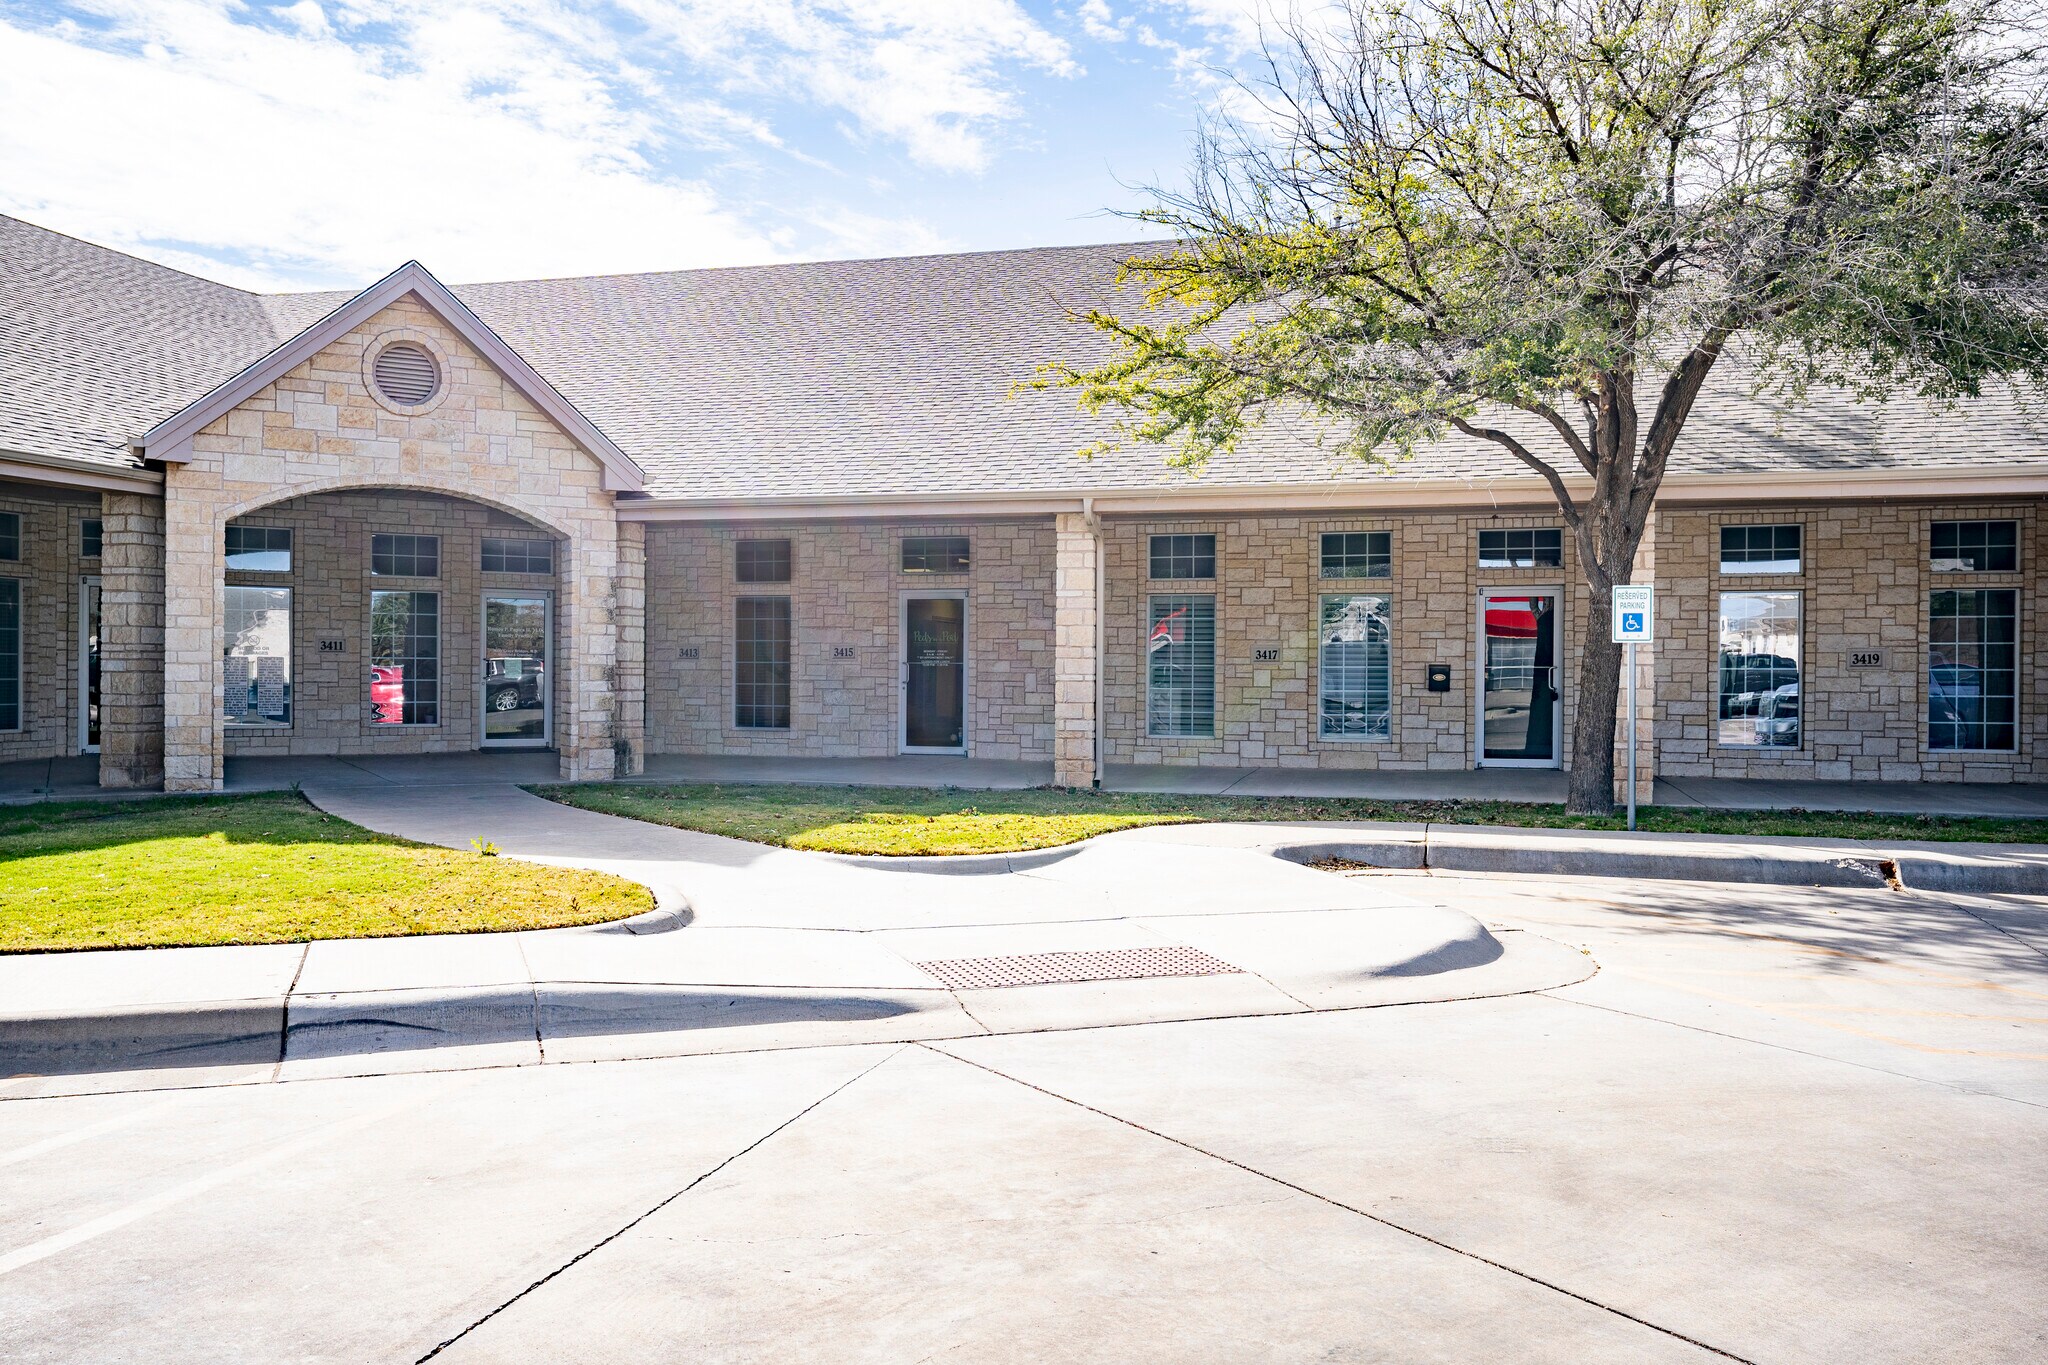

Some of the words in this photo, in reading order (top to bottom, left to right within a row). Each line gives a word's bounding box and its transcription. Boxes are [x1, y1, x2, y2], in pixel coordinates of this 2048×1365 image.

[1617, 592, 1648, 600] RESERVED
[1619, 601, 1645, 609] PARKING
[320, 640, 343, 651] 3411
[679, 648, 698, 658] 3413
[833, 647, 854, 657] 3415
[1255, 650, 1278, 660] 3417
[1852, 653, 1880, 665] 3419
